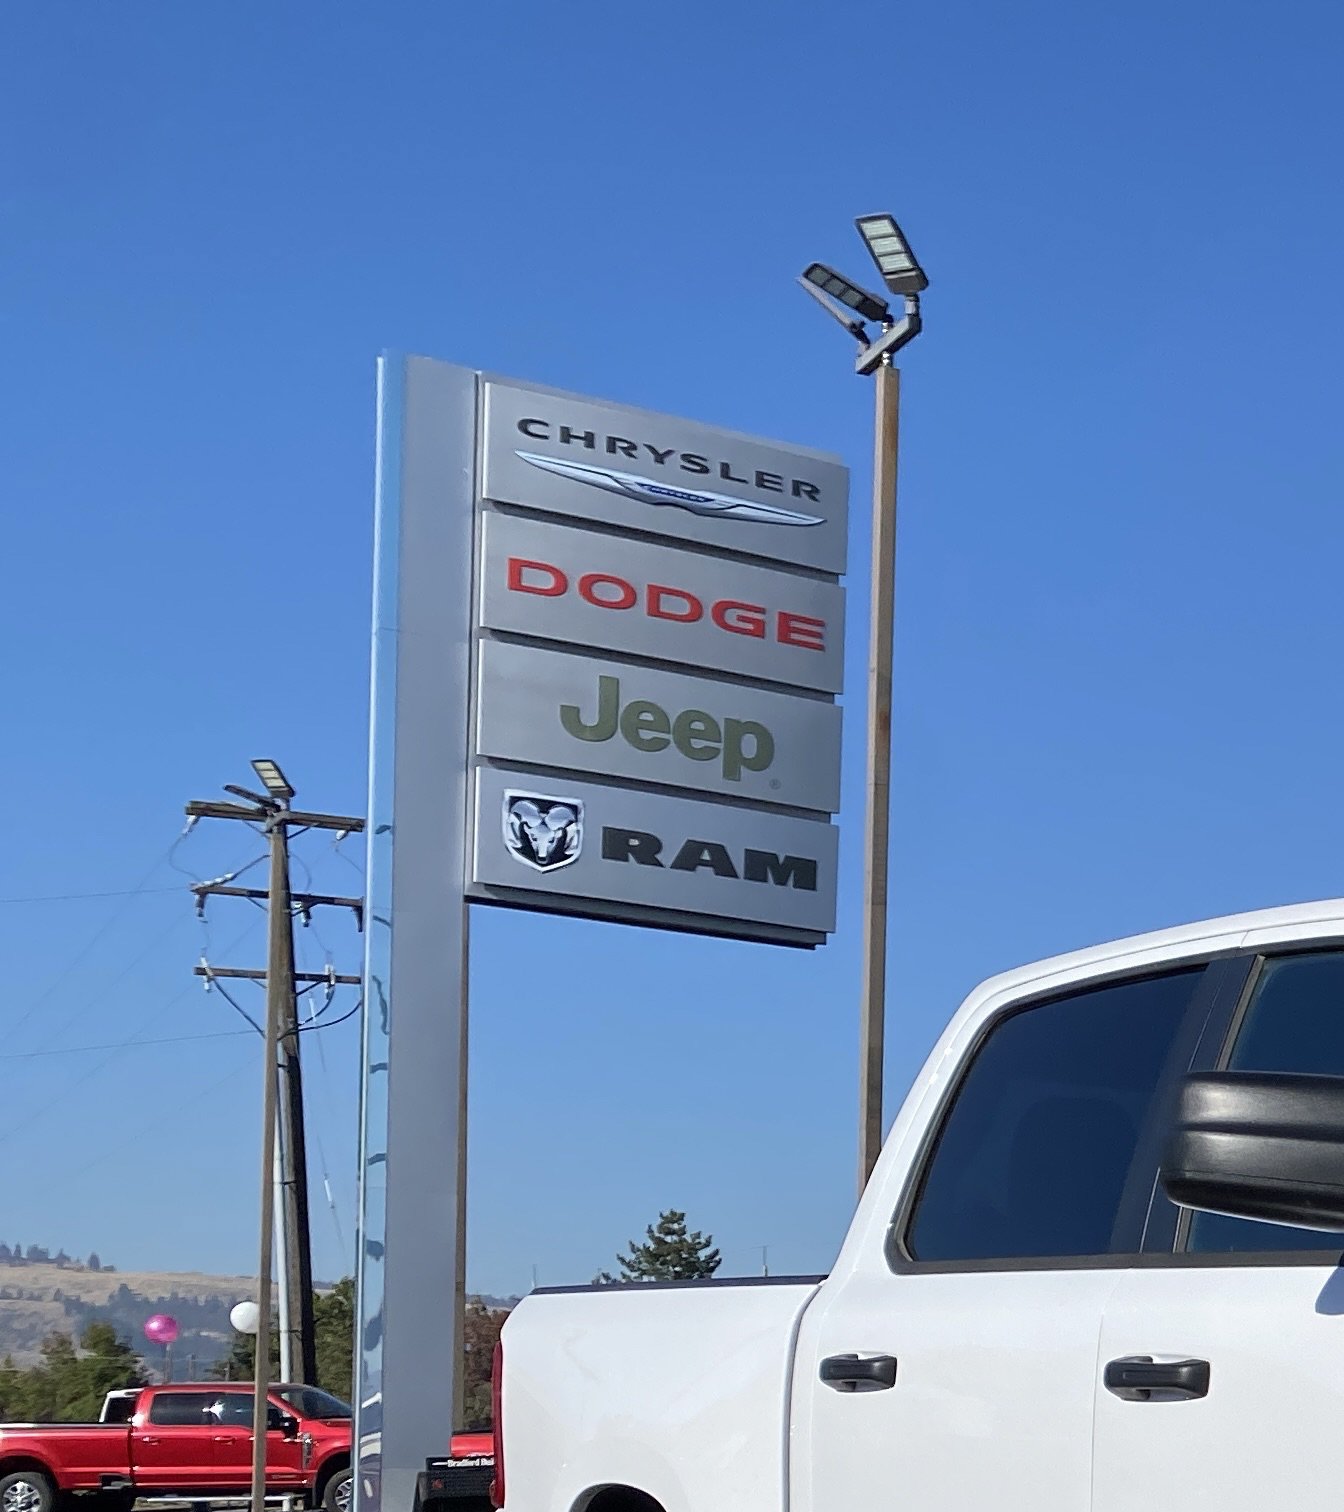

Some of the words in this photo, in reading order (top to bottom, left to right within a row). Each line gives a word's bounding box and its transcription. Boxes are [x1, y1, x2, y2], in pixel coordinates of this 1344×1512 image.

[517, 418, 820, 502] CHRYSLER
[507, 557, 826, 651] DODGE
[560, 675, 775, 781] Jeep
[602, 826, 817, 891] RAM
